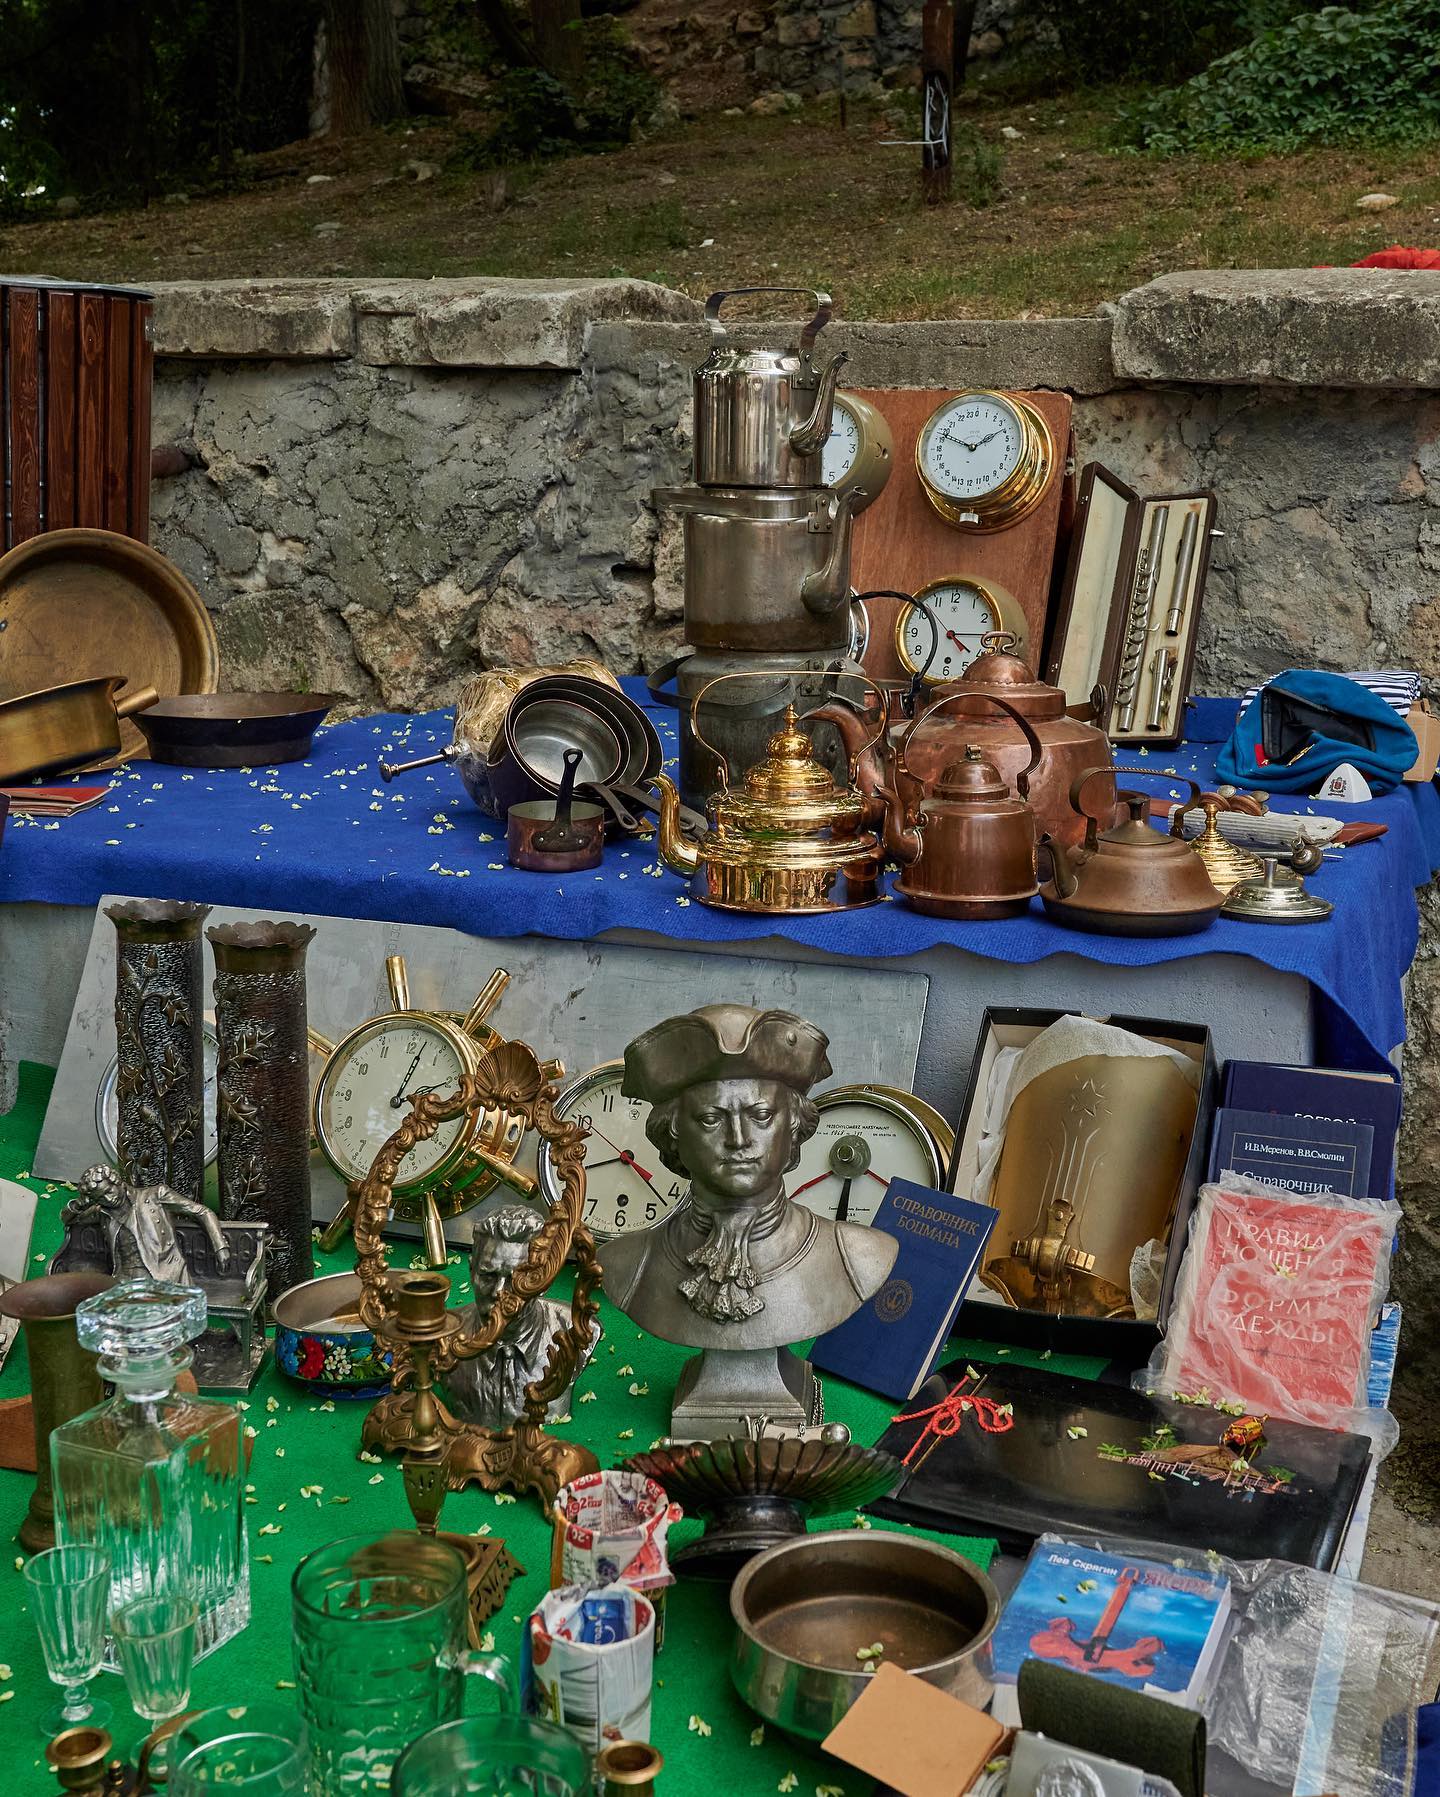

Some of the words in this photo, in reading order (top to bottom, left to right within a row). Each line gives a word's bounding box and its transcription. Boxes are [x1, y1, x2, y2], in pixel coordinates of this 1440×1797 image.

[966, 411, 974, 419] 23
[847, 426, 854, 437] 2
[849, 443, 856, 454] 3
[842, 460, 849, 469] 4
[828, 471, 836, 482] 5
[935, 597, 942, 607] 11
[951, 592, 960, 603] 12
[972, 598, 976, 609] 1
[918, 610, 928, 620] 10
[980, 613, 988, 623] 2
[911, 627, 918, 637] 9
[914, 645, 922, 655] 8
[942, 666, 950, 676] 6
[961, 661, 969, 672] 5
[380, 1046, 389, 1058] 11
[406, 1041, 417, 1054] 12
[358, 1063, 368, 1076] 10
[445, 1076, 453, 1088] 2
[345, 1089, 352, 1101] 9
[603, 1095, 614, 1112] 11
[344, 1116, 353, 1128] 8
[577, 1114, 593, 1131] 10
[359, 1139, 367, 1153] 7
[1242, 1171, 1333, 1194] Справочник
[668, 1182, 680, 1199] 4
[587, 1199, 598, 1216] 7
[645, 1203, 657, 1220] 5
[614, 1210, 626, 1227] 6
[892, 1195, 980, 1236] СПРАВОЧНИК
[896, 1215, 960, 1249] БОЦМАНА
[1048, 1554, 1069, 1566] Лев
[1072, 1559, 1118, 1576] Скрягин
